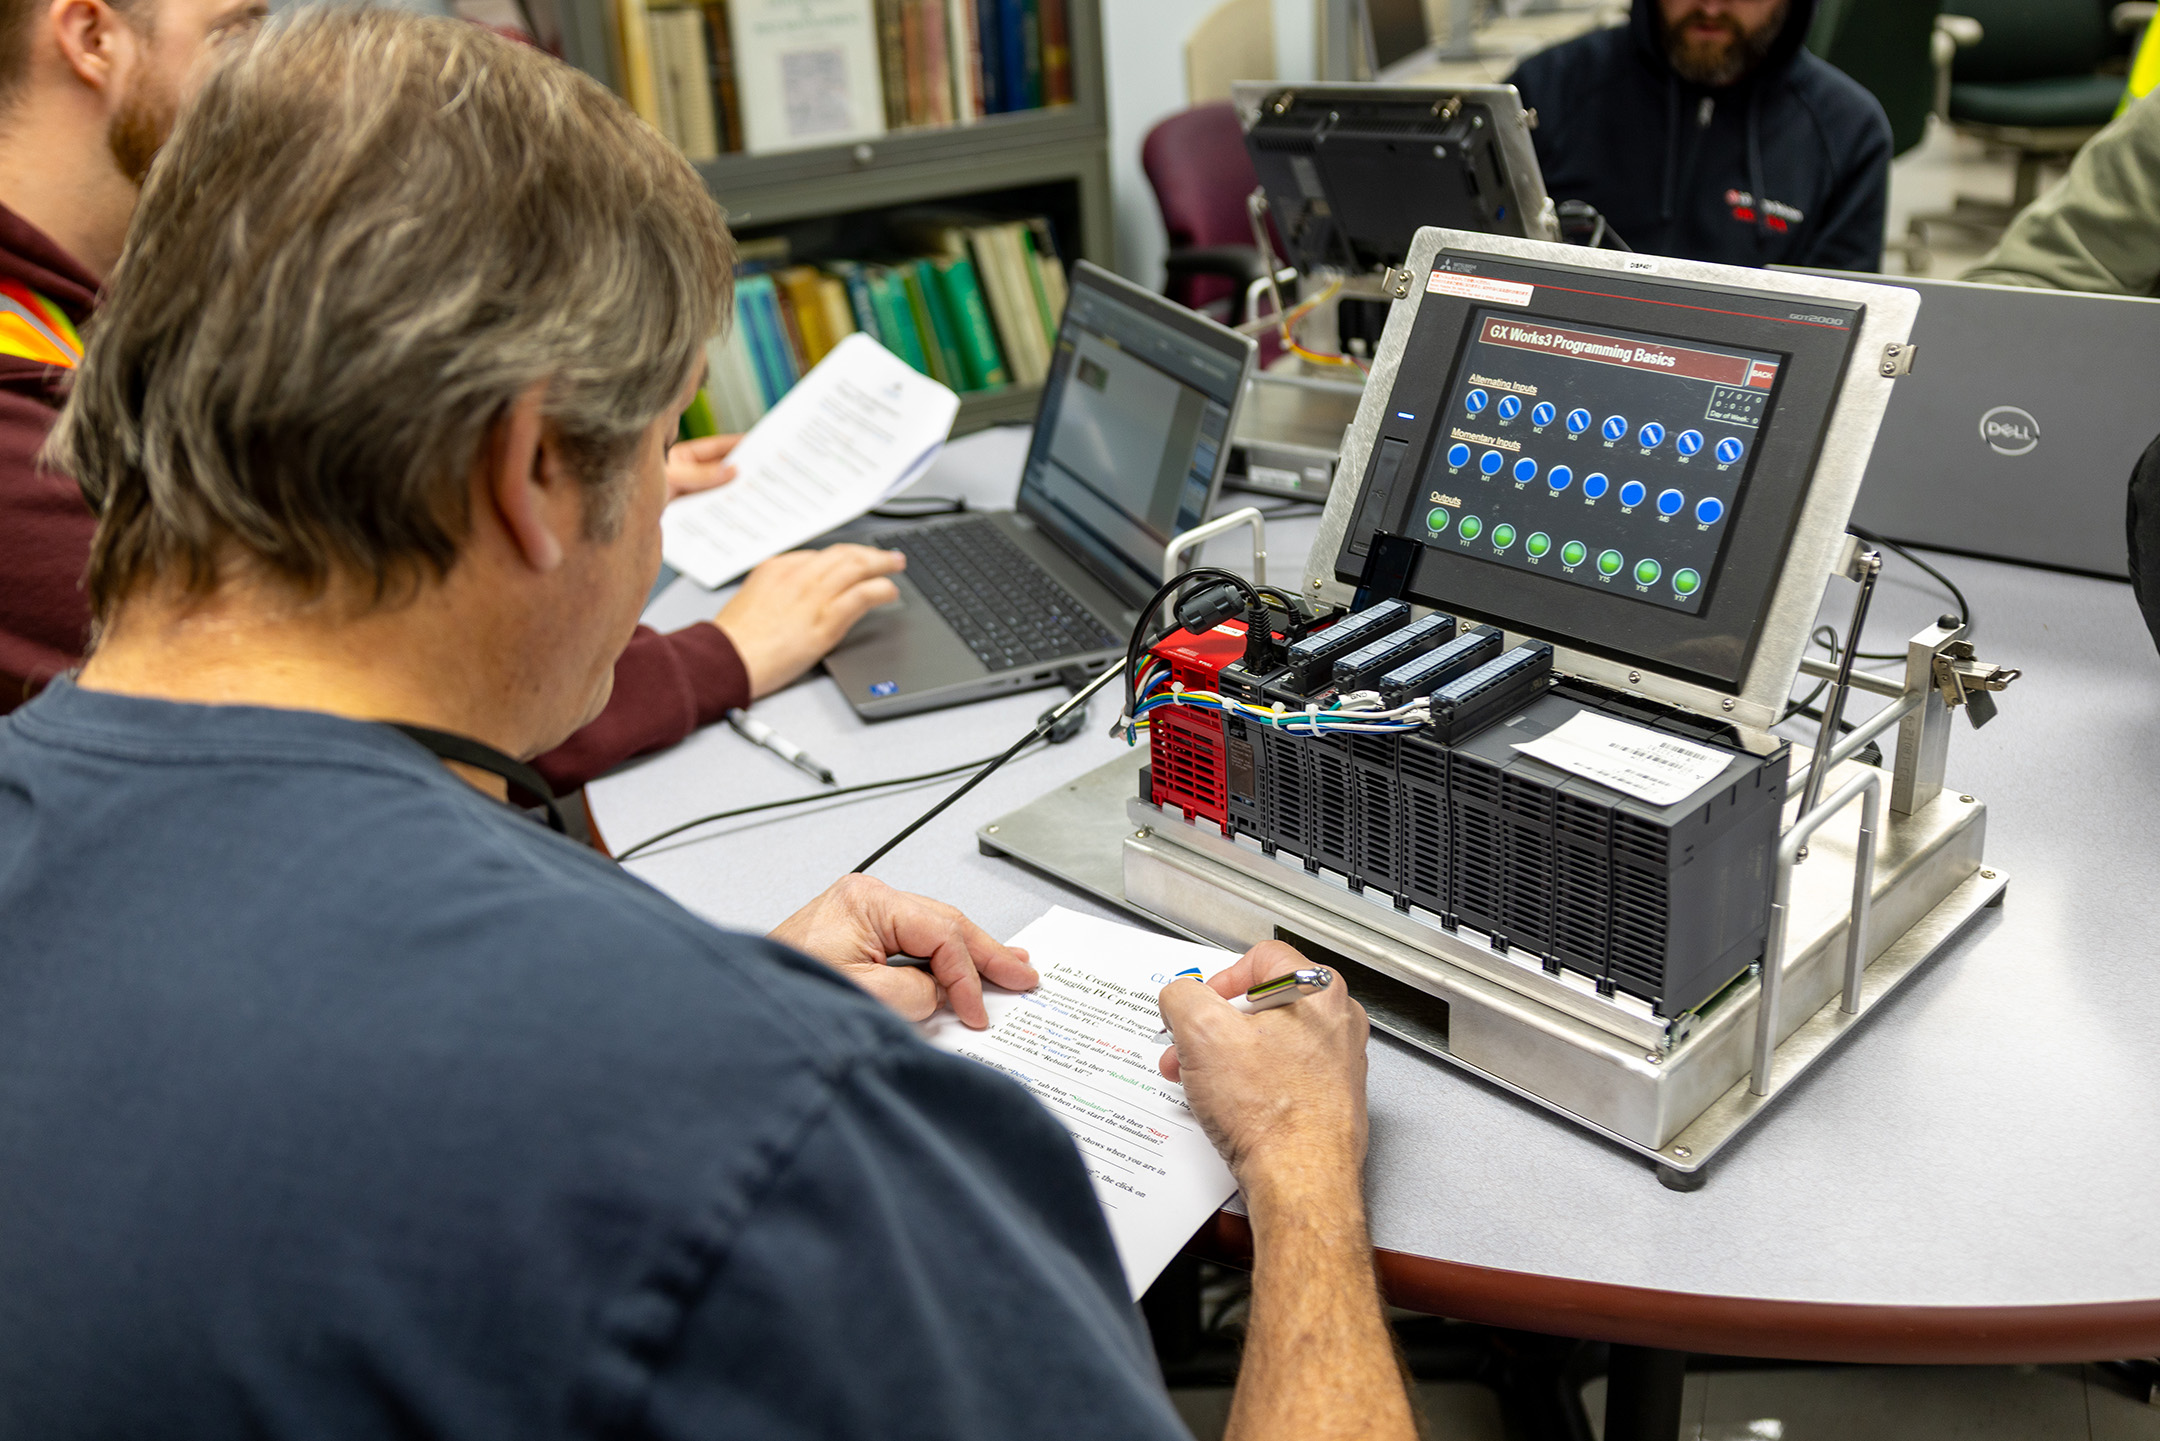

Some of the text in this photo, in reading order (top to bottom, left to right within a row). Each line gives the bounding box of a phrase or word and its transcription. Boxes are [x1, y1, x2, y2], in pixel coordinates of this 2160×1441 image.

[1490, 324, 1676, 368] GX Works3 Programming Basics
[1469, 373, 1538, 394] Alternating Inputs
[1751, 369, 1774, 379] BACK
[1709, 410, 1723, 419] Day
[1730, 414, 1749, 423] Week:
[1452, 427, 1522, 450] Momentary Inputs
[1533, 426, 1543, 434] M2
[1430, 491, 1462, 506] Outputs
[1043, 971, 1093, 995] debugging
[1093, 988, 1119, 1001] PLC
[1053, 962, 1073, 975] Lab
[1073, 970, 1084, 978] 2:
[1085, 973, 1128, 995] Creating,
[1051, 991, 1080, 1005] prepare
[1087, 1003, 1110, 1016] create
[1109, 1012, 1127, 1022] PLC
[1075, 1007, 1106, 1023] required
[1014, 1015, 1032, 1026] Click
[1075, 1040, 1091, 1050] and
[1090, 1046, 1104, 1056] add
[1102, 1052, 1124, 1062] your
[1122, 1056, 1148, 1071] initials
[1022, 1028, 1038, 1037] save
[1037, 1034, 1050, 1042] the
[1044, 1018, 1064, 1031] select
[1064, 1026, 1078, 1036] and
[1078, 1032, 1096, 1044] open
[991, 1034, 1010, 1045] when
[1009, 1040, 1022, 1050] you
[1021, 1046, 1039, 1057] click
[1026, 1038, 1039, 1047] the
[1075, 1057, 1089, 1067] tab
[1088, 1063, 1105, 1074] then
[1158, 1090, 1180, 1105] What
[1037, 1080, 1051, 1090] tab
[1050, 1086, 1068, 1097] then
[1112, 1112, 1127, 1122] tab
[1126, 1118, 1144, 1130] then
[1052, 1094, 1072, 1107] when
[1070, 1103, 1087, 1114] you
[1087, 1109, 1105, 1121] start
[1105, 1117, 1119, 1127] the
[1119, 1123, 1165, 1146] simulation?
[1082, 1135, 1105, 1150] shows
[1106, 1145, 1128, 1160] when
[1125, 1156, 1144, 1167] you
[1142, 1163, 1158, 1173] are
[1157, 1168, 1167, 1177] in
[1101, 1174, 1116, 1185] the
[1115, 1180, 1135, 1194] click
[1135, 1189, 1147, 1199] on
